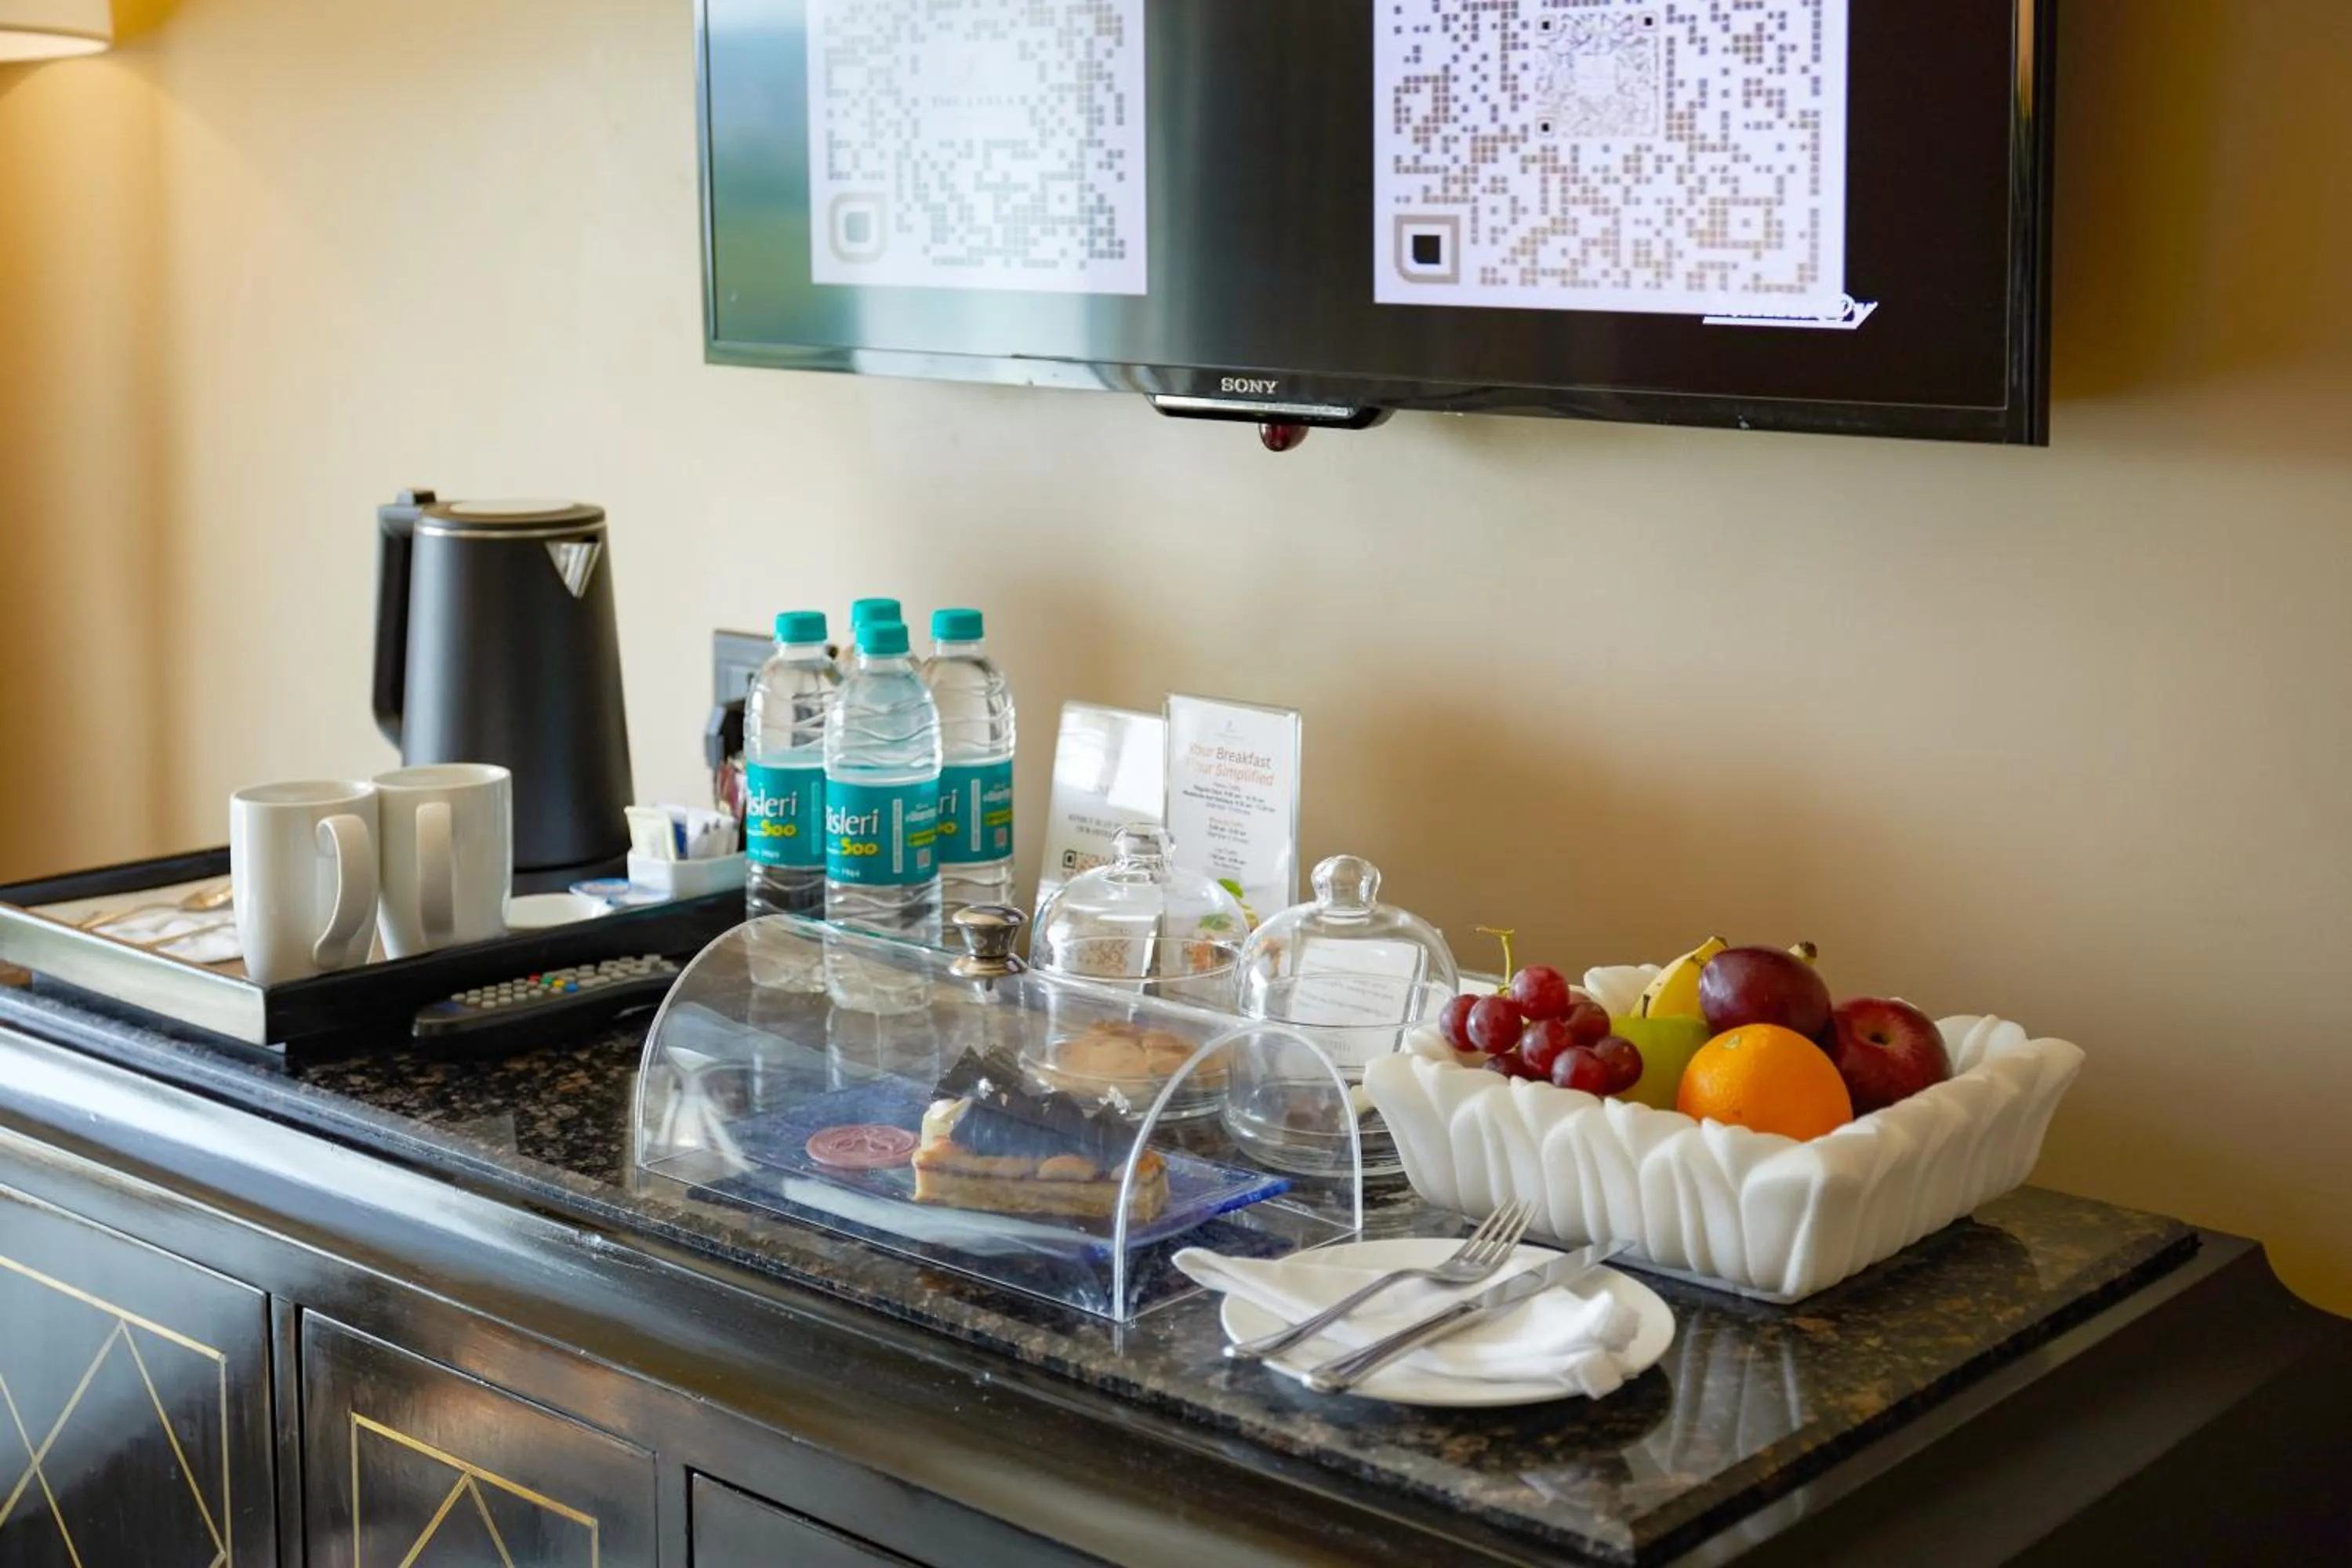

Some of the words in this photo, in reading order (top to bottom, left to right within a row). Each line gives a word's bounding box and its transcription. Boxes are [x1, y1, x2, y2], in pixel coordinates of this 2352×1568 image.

[1221, 377, 1279, 395] SONY
[1216, 746, 1272, 769] Breakfast
[1216, 763, 1275, 786] Simplified
[746, 787, 797, 817] isleri
[760, 818, 797, 837] 500
[826, 804, 879, 836] isleri
[840, 837, 879, 856] 500
